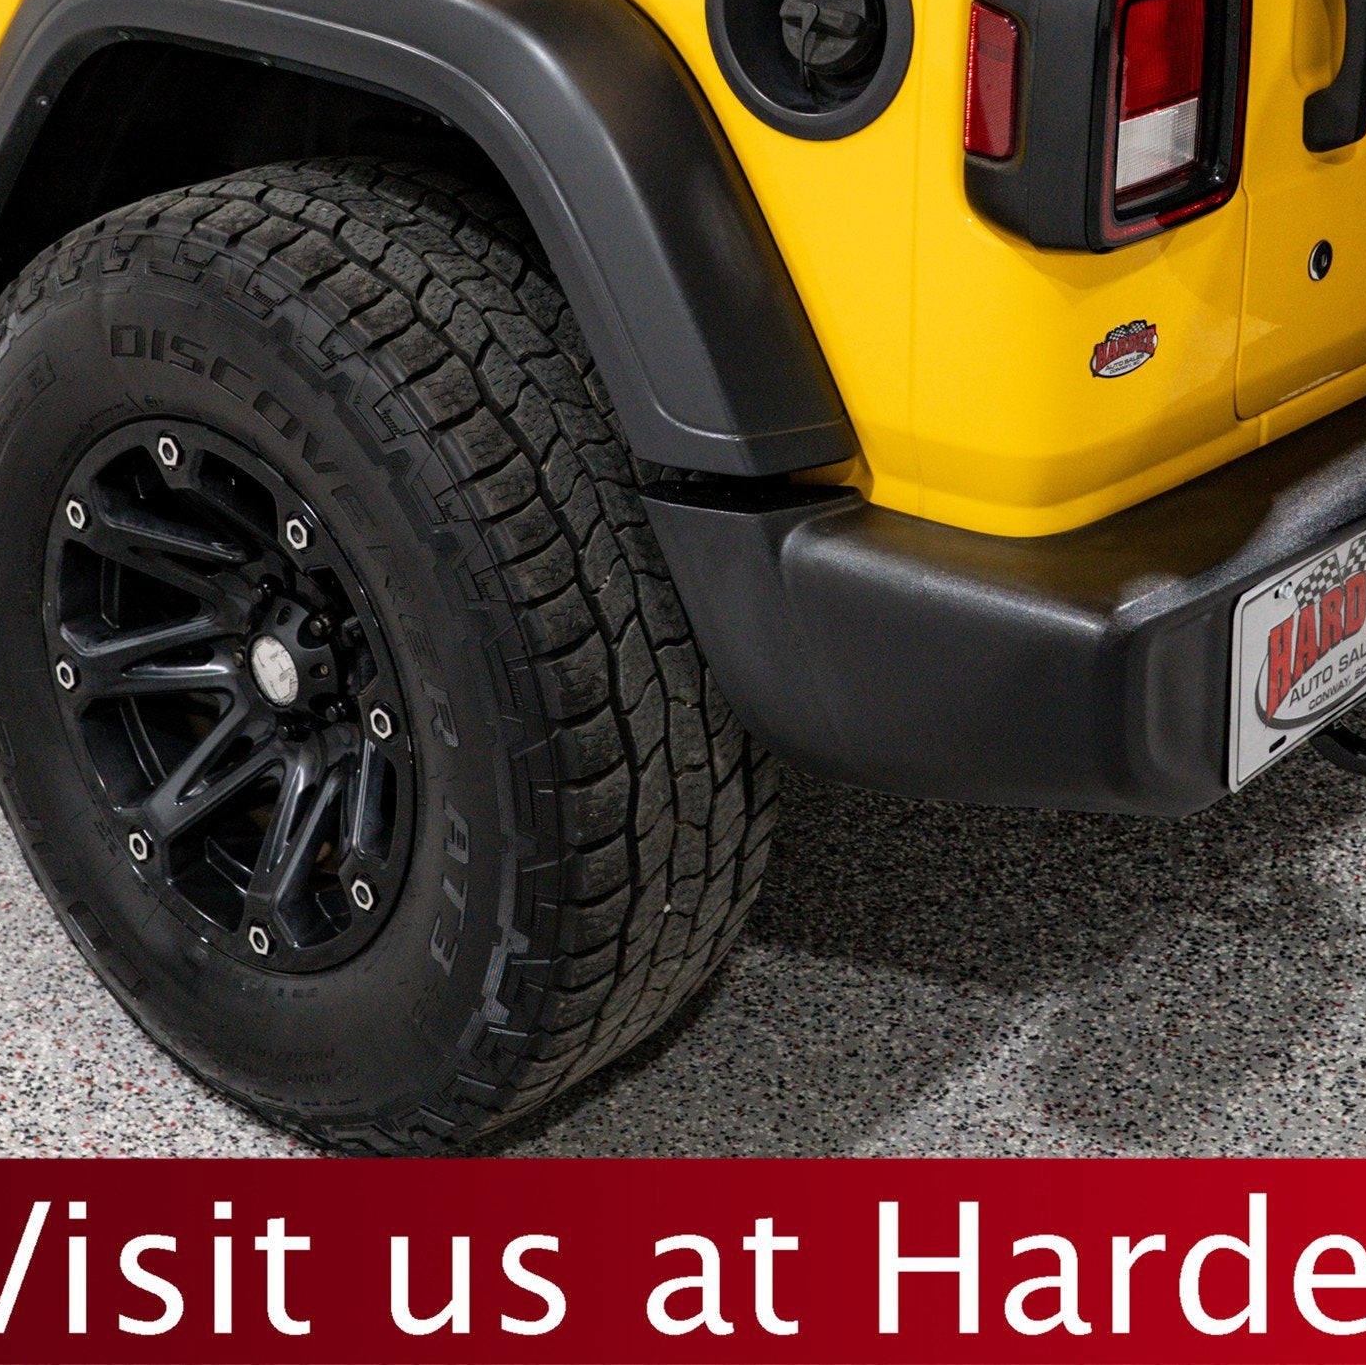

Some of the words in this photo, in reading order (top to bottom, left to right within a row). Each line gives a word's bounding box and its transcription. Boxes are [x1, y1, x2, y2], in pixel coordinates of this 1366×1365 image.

[1094, 325, 1156, 374] HARDEE
[1105, 360, 1123, 371] AUTO
[1289, 665, 1333, 707] AUTO
[429, 796, 472, 975] AT3
